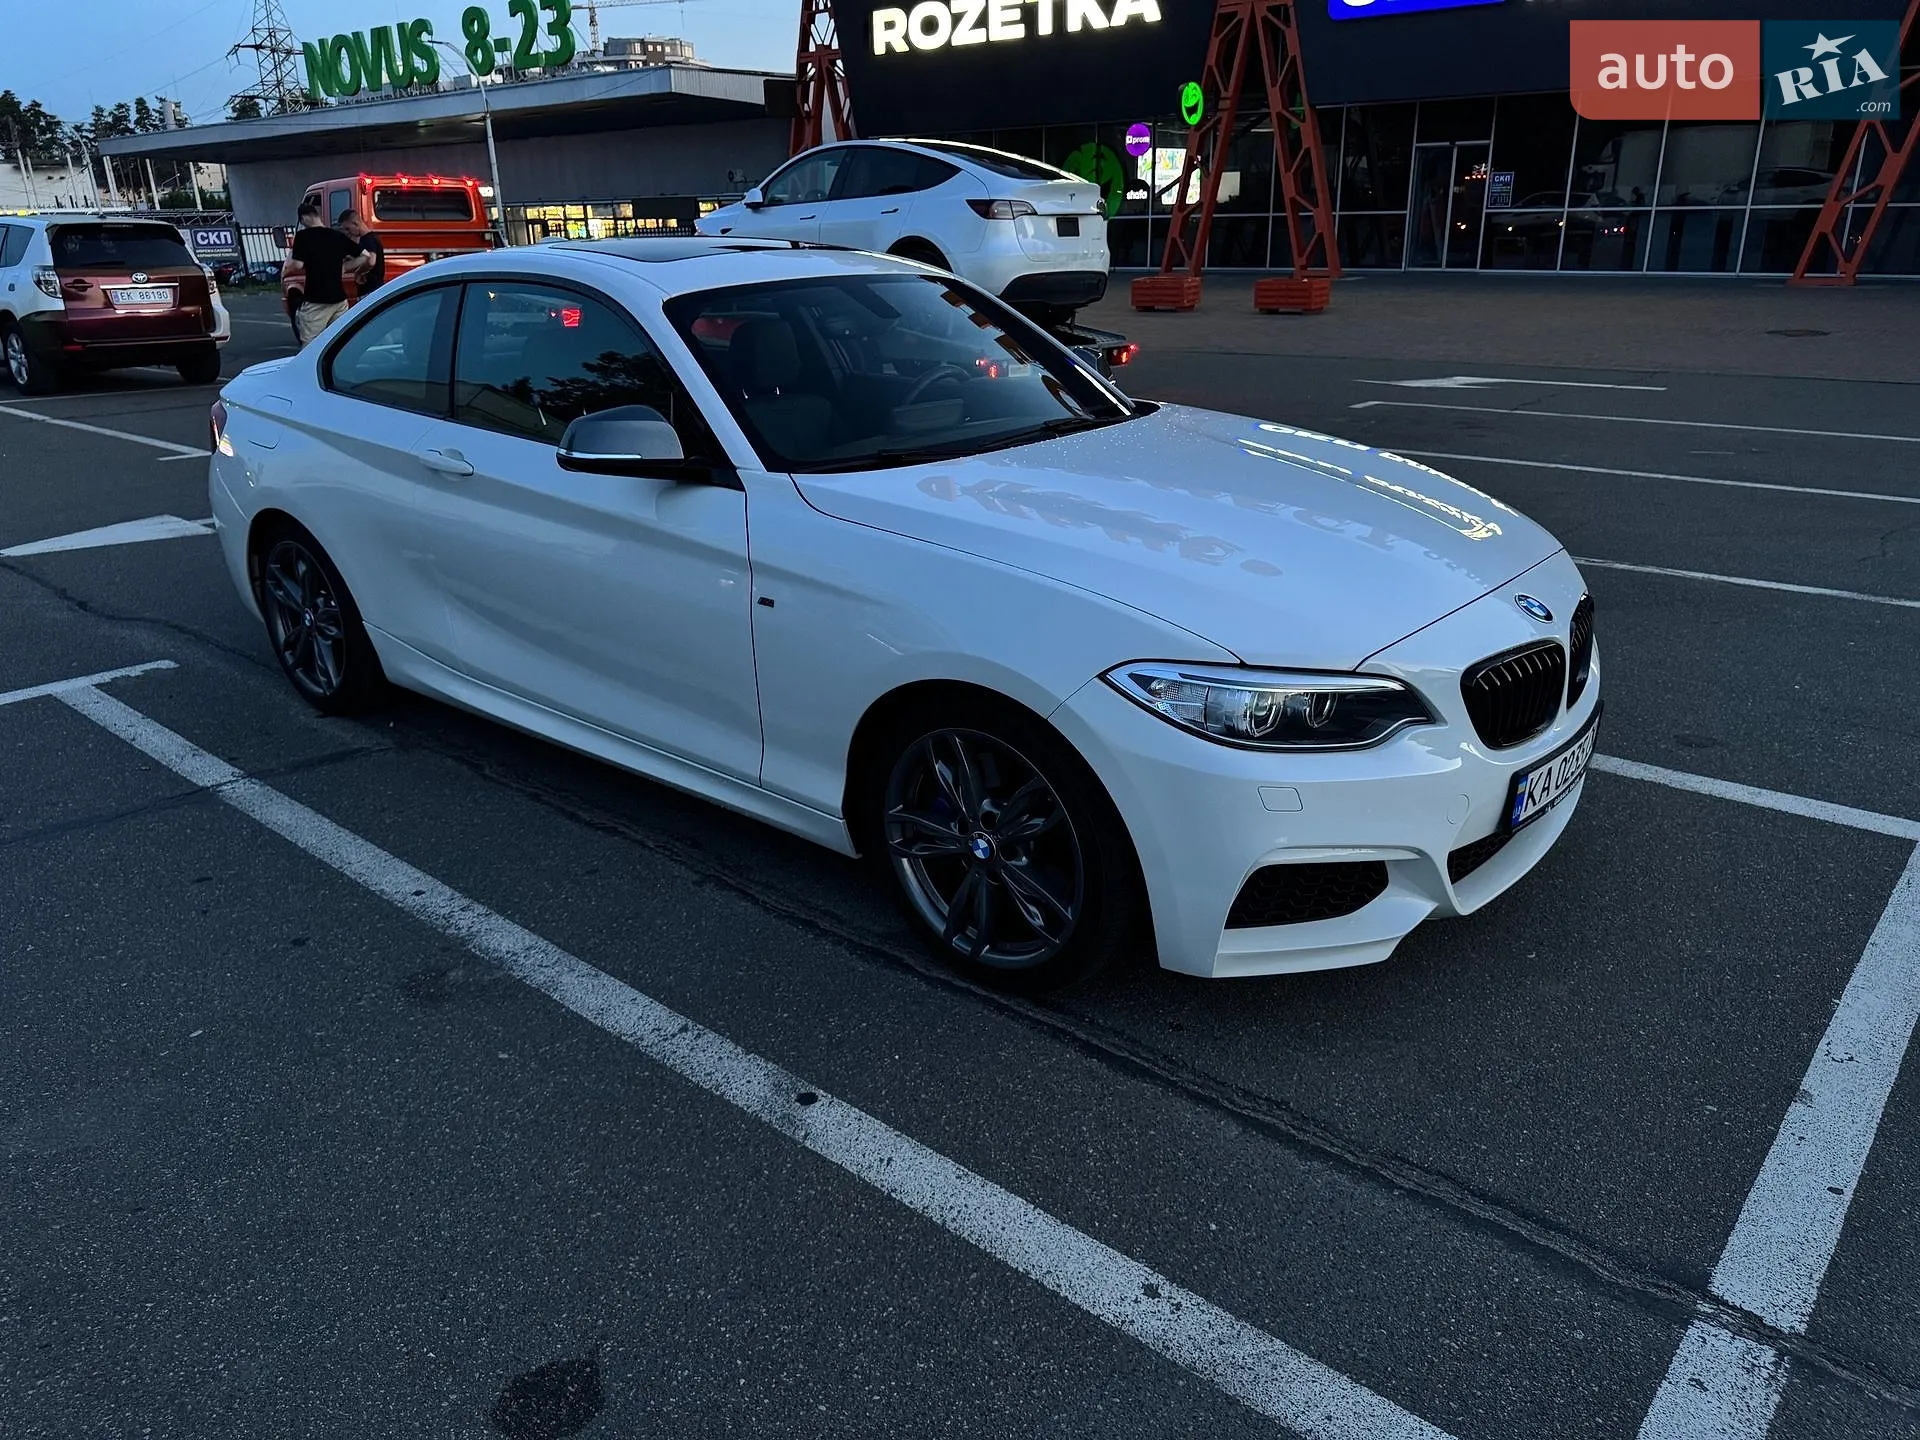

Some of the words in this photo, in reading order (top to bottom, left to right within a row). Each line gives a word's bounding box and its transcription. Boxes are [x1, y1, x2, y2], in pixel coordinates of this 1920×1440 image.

[301, 18, 440, 99] NOVUS
[461, 0, 576, 76] 8-23
[197, 231, 231, 245] СКП
